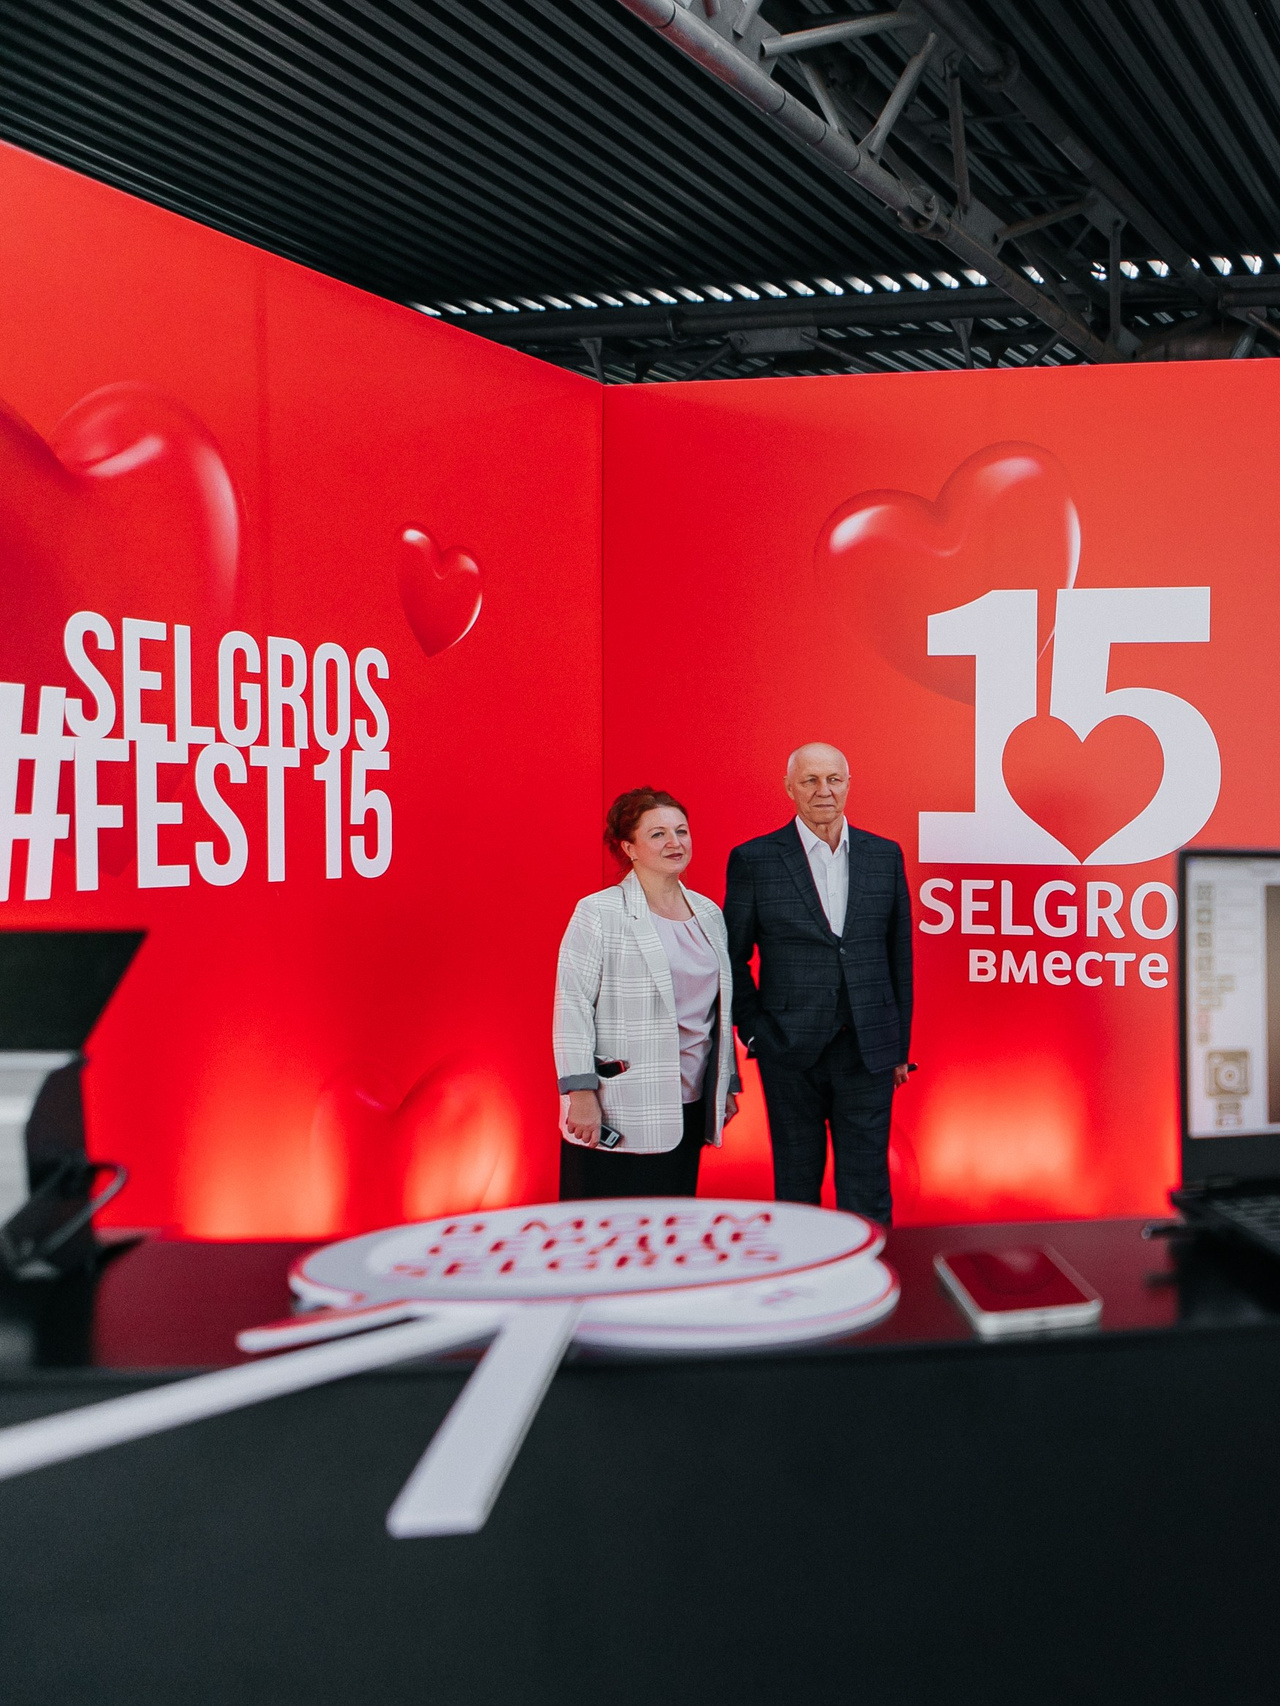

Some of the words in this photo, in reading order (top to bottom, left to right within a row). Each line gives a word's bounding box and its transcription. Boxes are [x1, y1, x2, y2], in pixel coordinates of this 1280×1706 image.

[63, 611, 391, 753] SELGROS
[918, 586, 1222, 866] 15
[918, 878, 1180, 940] SELGRO
